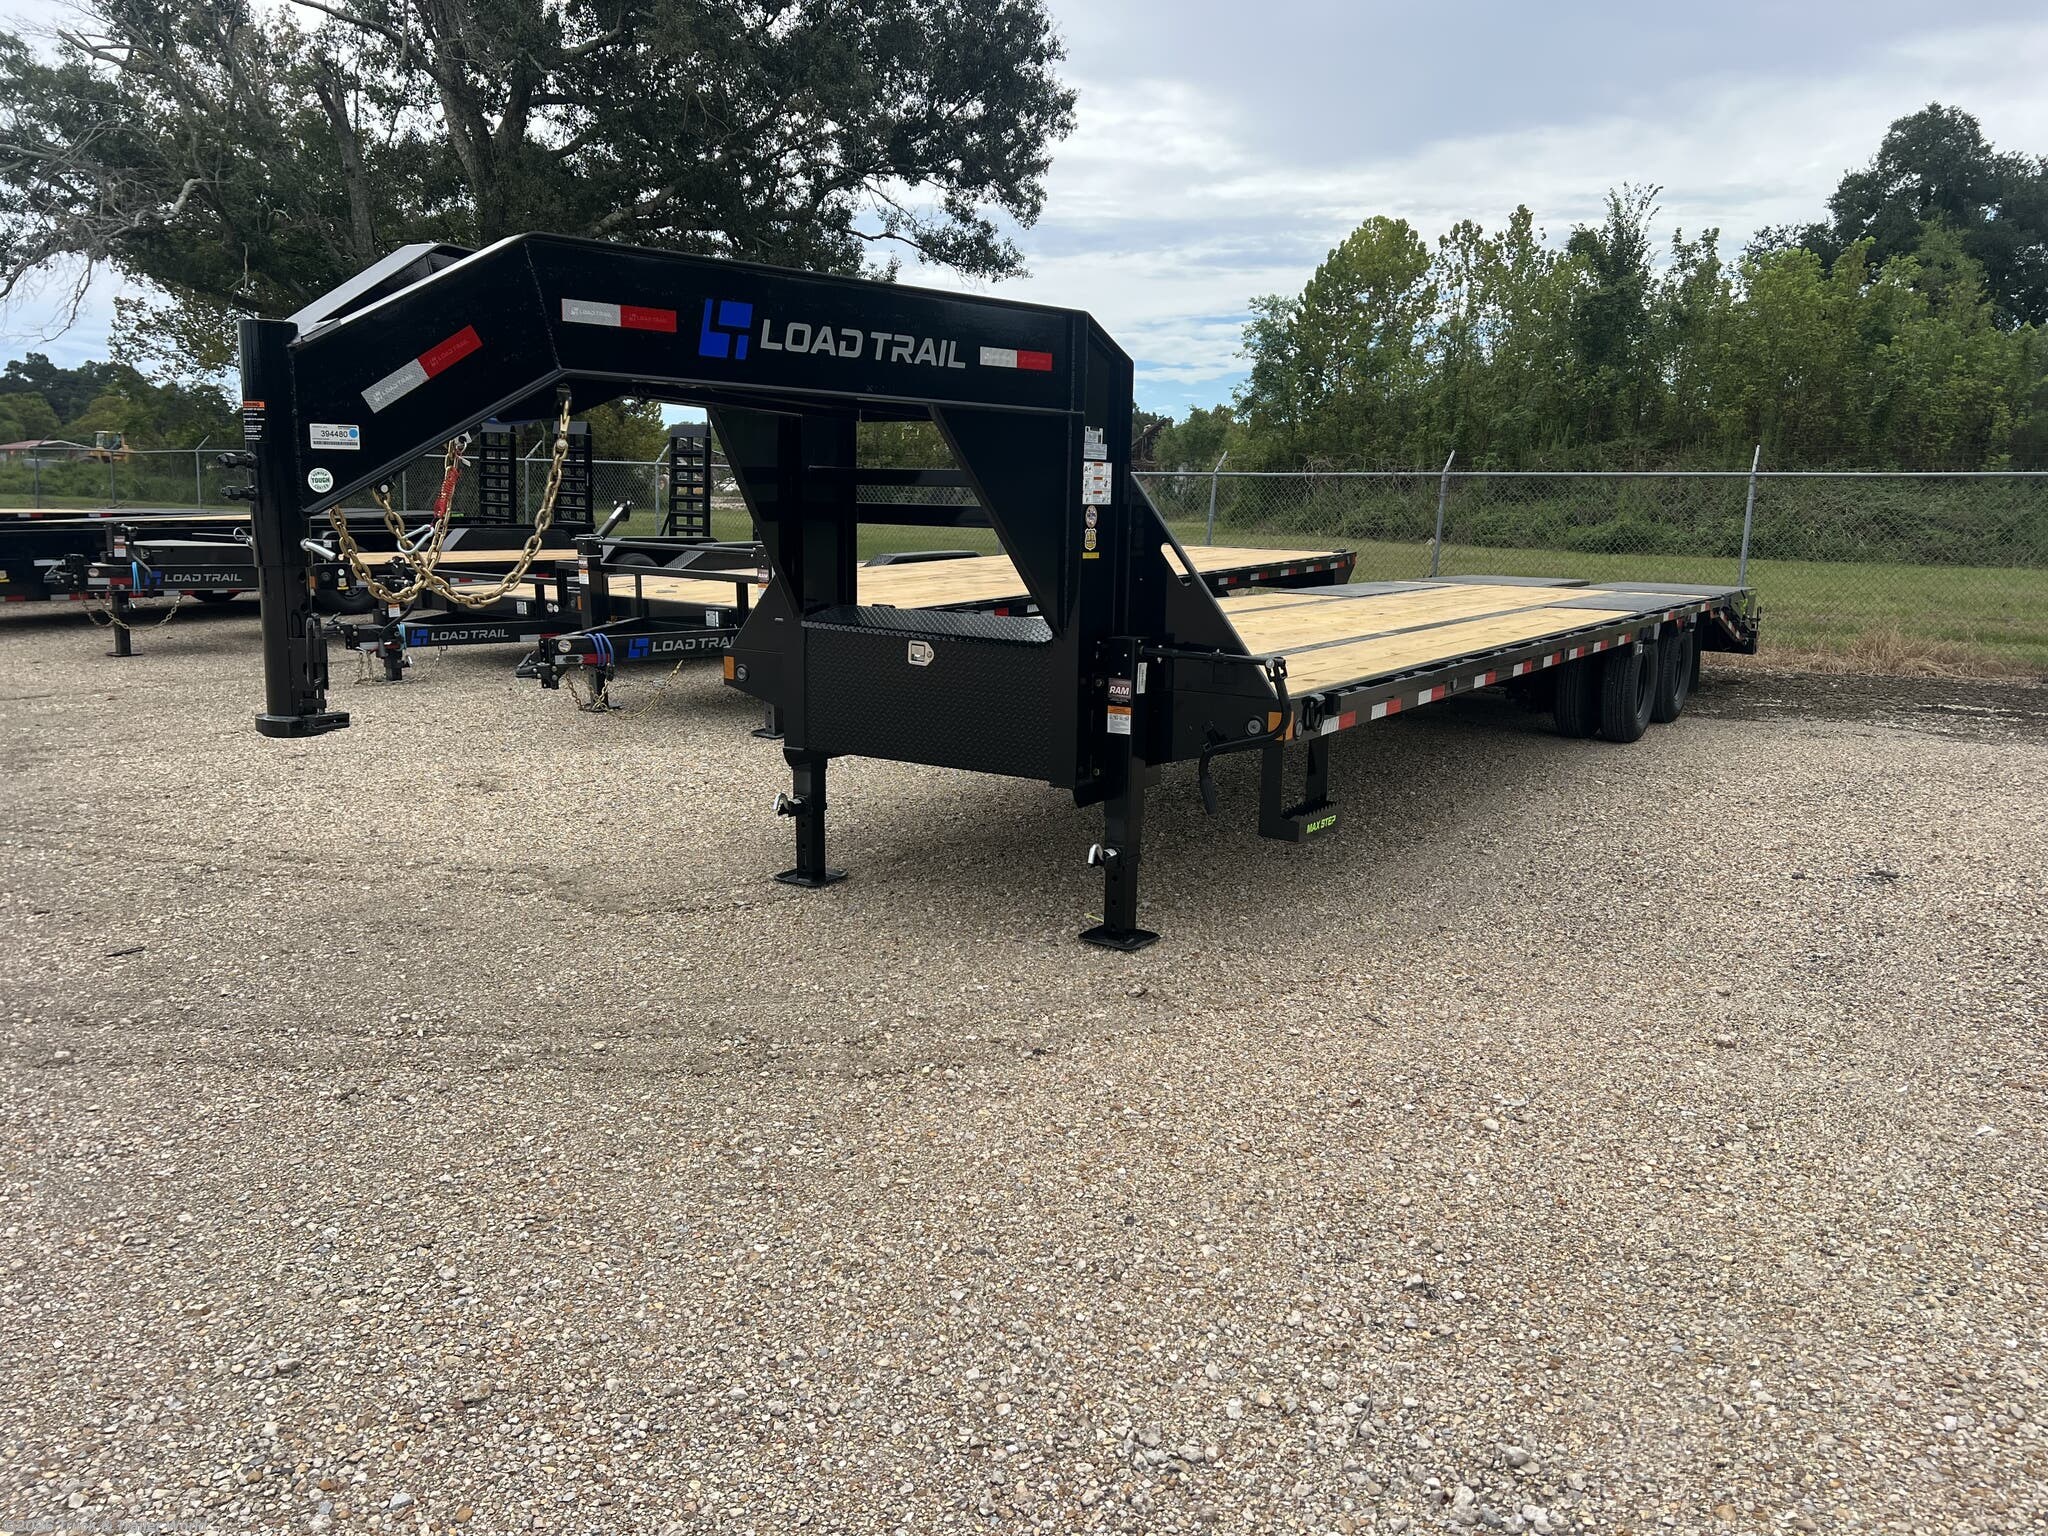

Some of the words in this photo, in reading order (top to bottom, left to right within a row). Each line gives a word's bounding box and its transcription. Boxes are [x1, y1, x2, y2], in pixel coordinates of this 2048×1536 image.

[760, 319, 864, 358] LOAD
[870, 331, 966, 369] TRAIL
[164, 573, 201, 582] LOAD
[202, 573, 242, 582] TRAIL
[430, 630, 468, 641] LOAD
[470, 629, 509, 638] TRAIL
[652, 638, 696, 652] LOAD
[698, 636, 735, 648] TRAI
[1109, 685, 1130, 695] RAM
[1306, 821, 1321, 834] MAX
[1320, 814, 1337, 829] STEP
